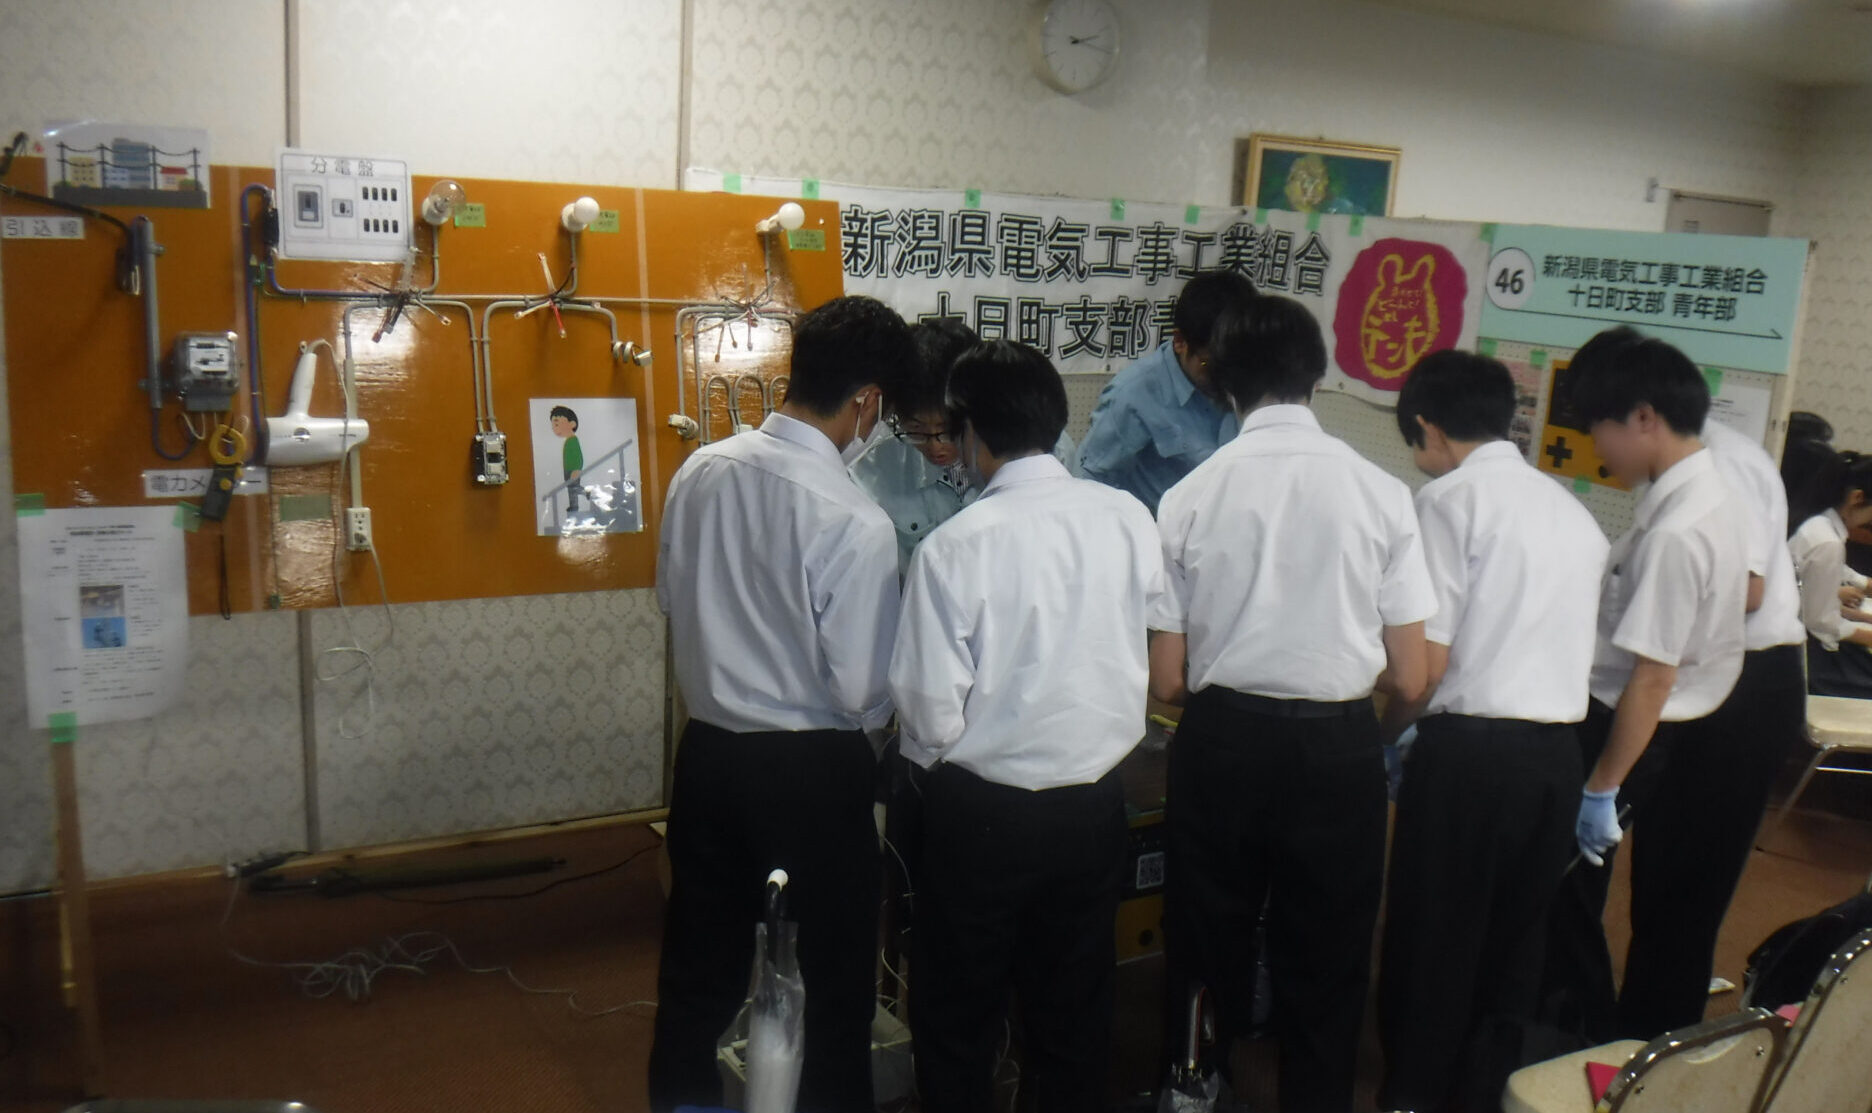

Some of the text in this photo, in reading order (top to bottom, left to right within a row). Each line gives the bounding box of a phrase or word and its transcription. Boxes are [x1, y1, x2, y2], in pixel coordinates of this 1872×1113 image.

[310, 154, 374, 177] 分電盤
[840, 204, 1331, 297] 新潟県電気工事工業組合
[1494, 267, 1525, 295] 46
[1542, 254, 1768, 295] 新潟県電気工事工業組合
[1567, 283, 1738, 322] 十日町支部 青年部
[151, 475, 262, 493] 電力メー
